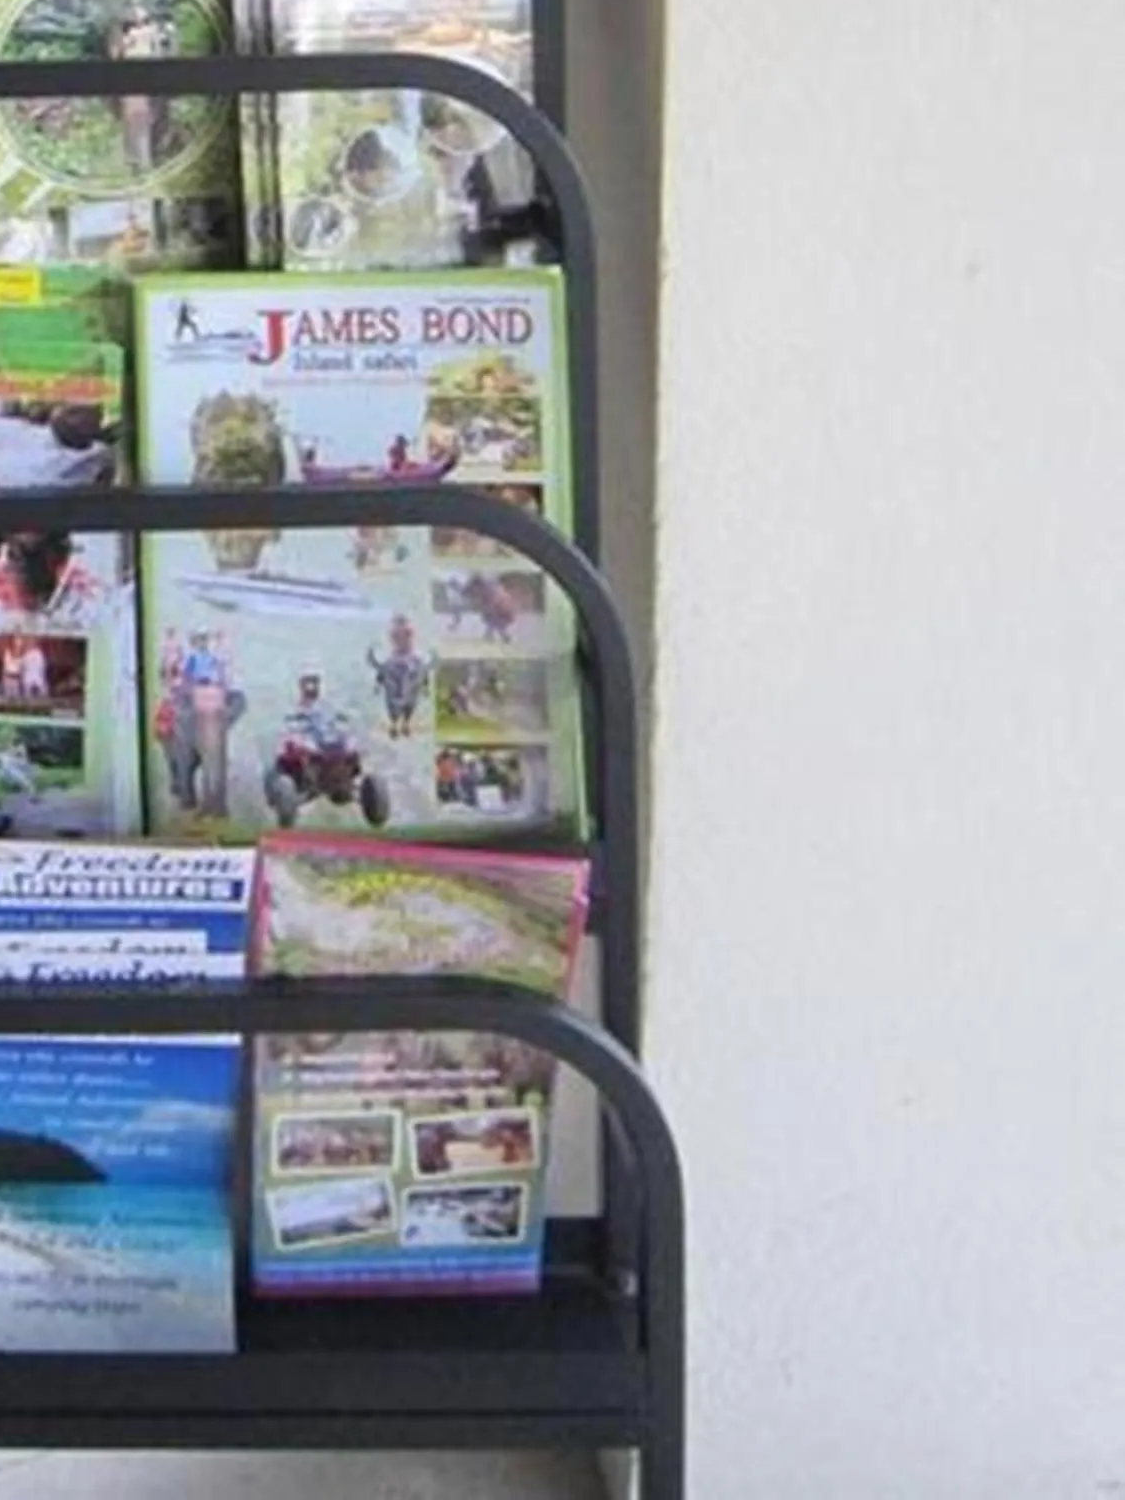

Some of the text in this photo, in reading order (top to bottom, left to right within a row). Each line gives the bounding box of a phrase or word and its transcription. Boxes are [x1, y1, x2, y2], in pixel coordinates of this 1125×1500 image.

[247, 306, 535, 366] JAMES BOND
[33, 850, 242, 873] Freedom
